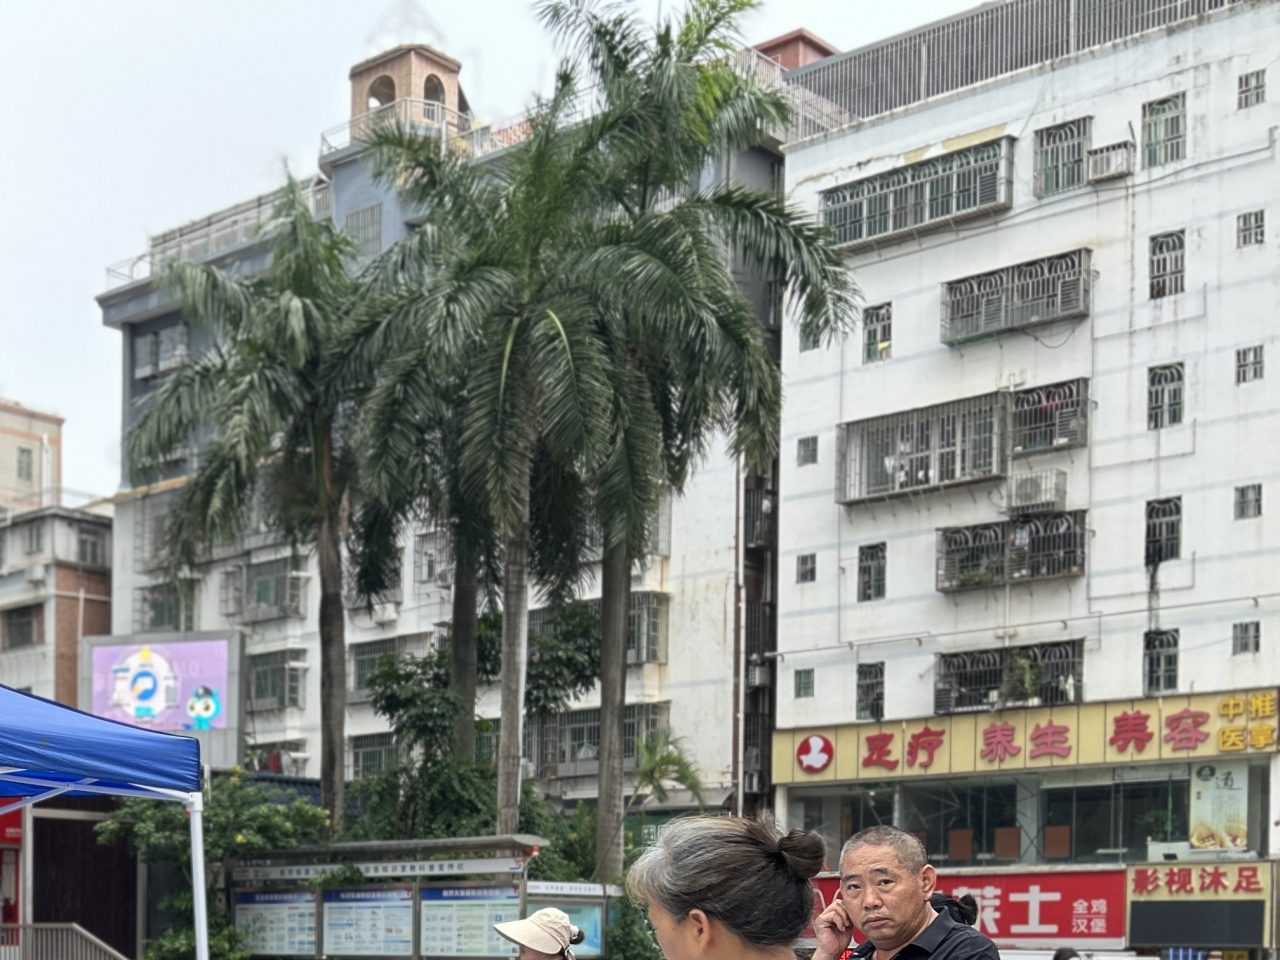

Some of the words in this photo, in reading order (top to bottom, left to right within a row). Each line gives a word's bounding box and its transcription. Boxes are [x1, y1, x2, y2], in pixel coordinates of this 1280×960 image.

[862, 726, 945, 770] 足疗
[980, 719, 1073, 762] 养生
[1109, 708, 1211, 752] 美容
[1131, 865, 1265, 895] 影视沐足
[933, 884, 1062, 934] 莱士
[1072, 899, 1108, 913] 全鸡
[1072, 919, 1108, 933] 汉堡
